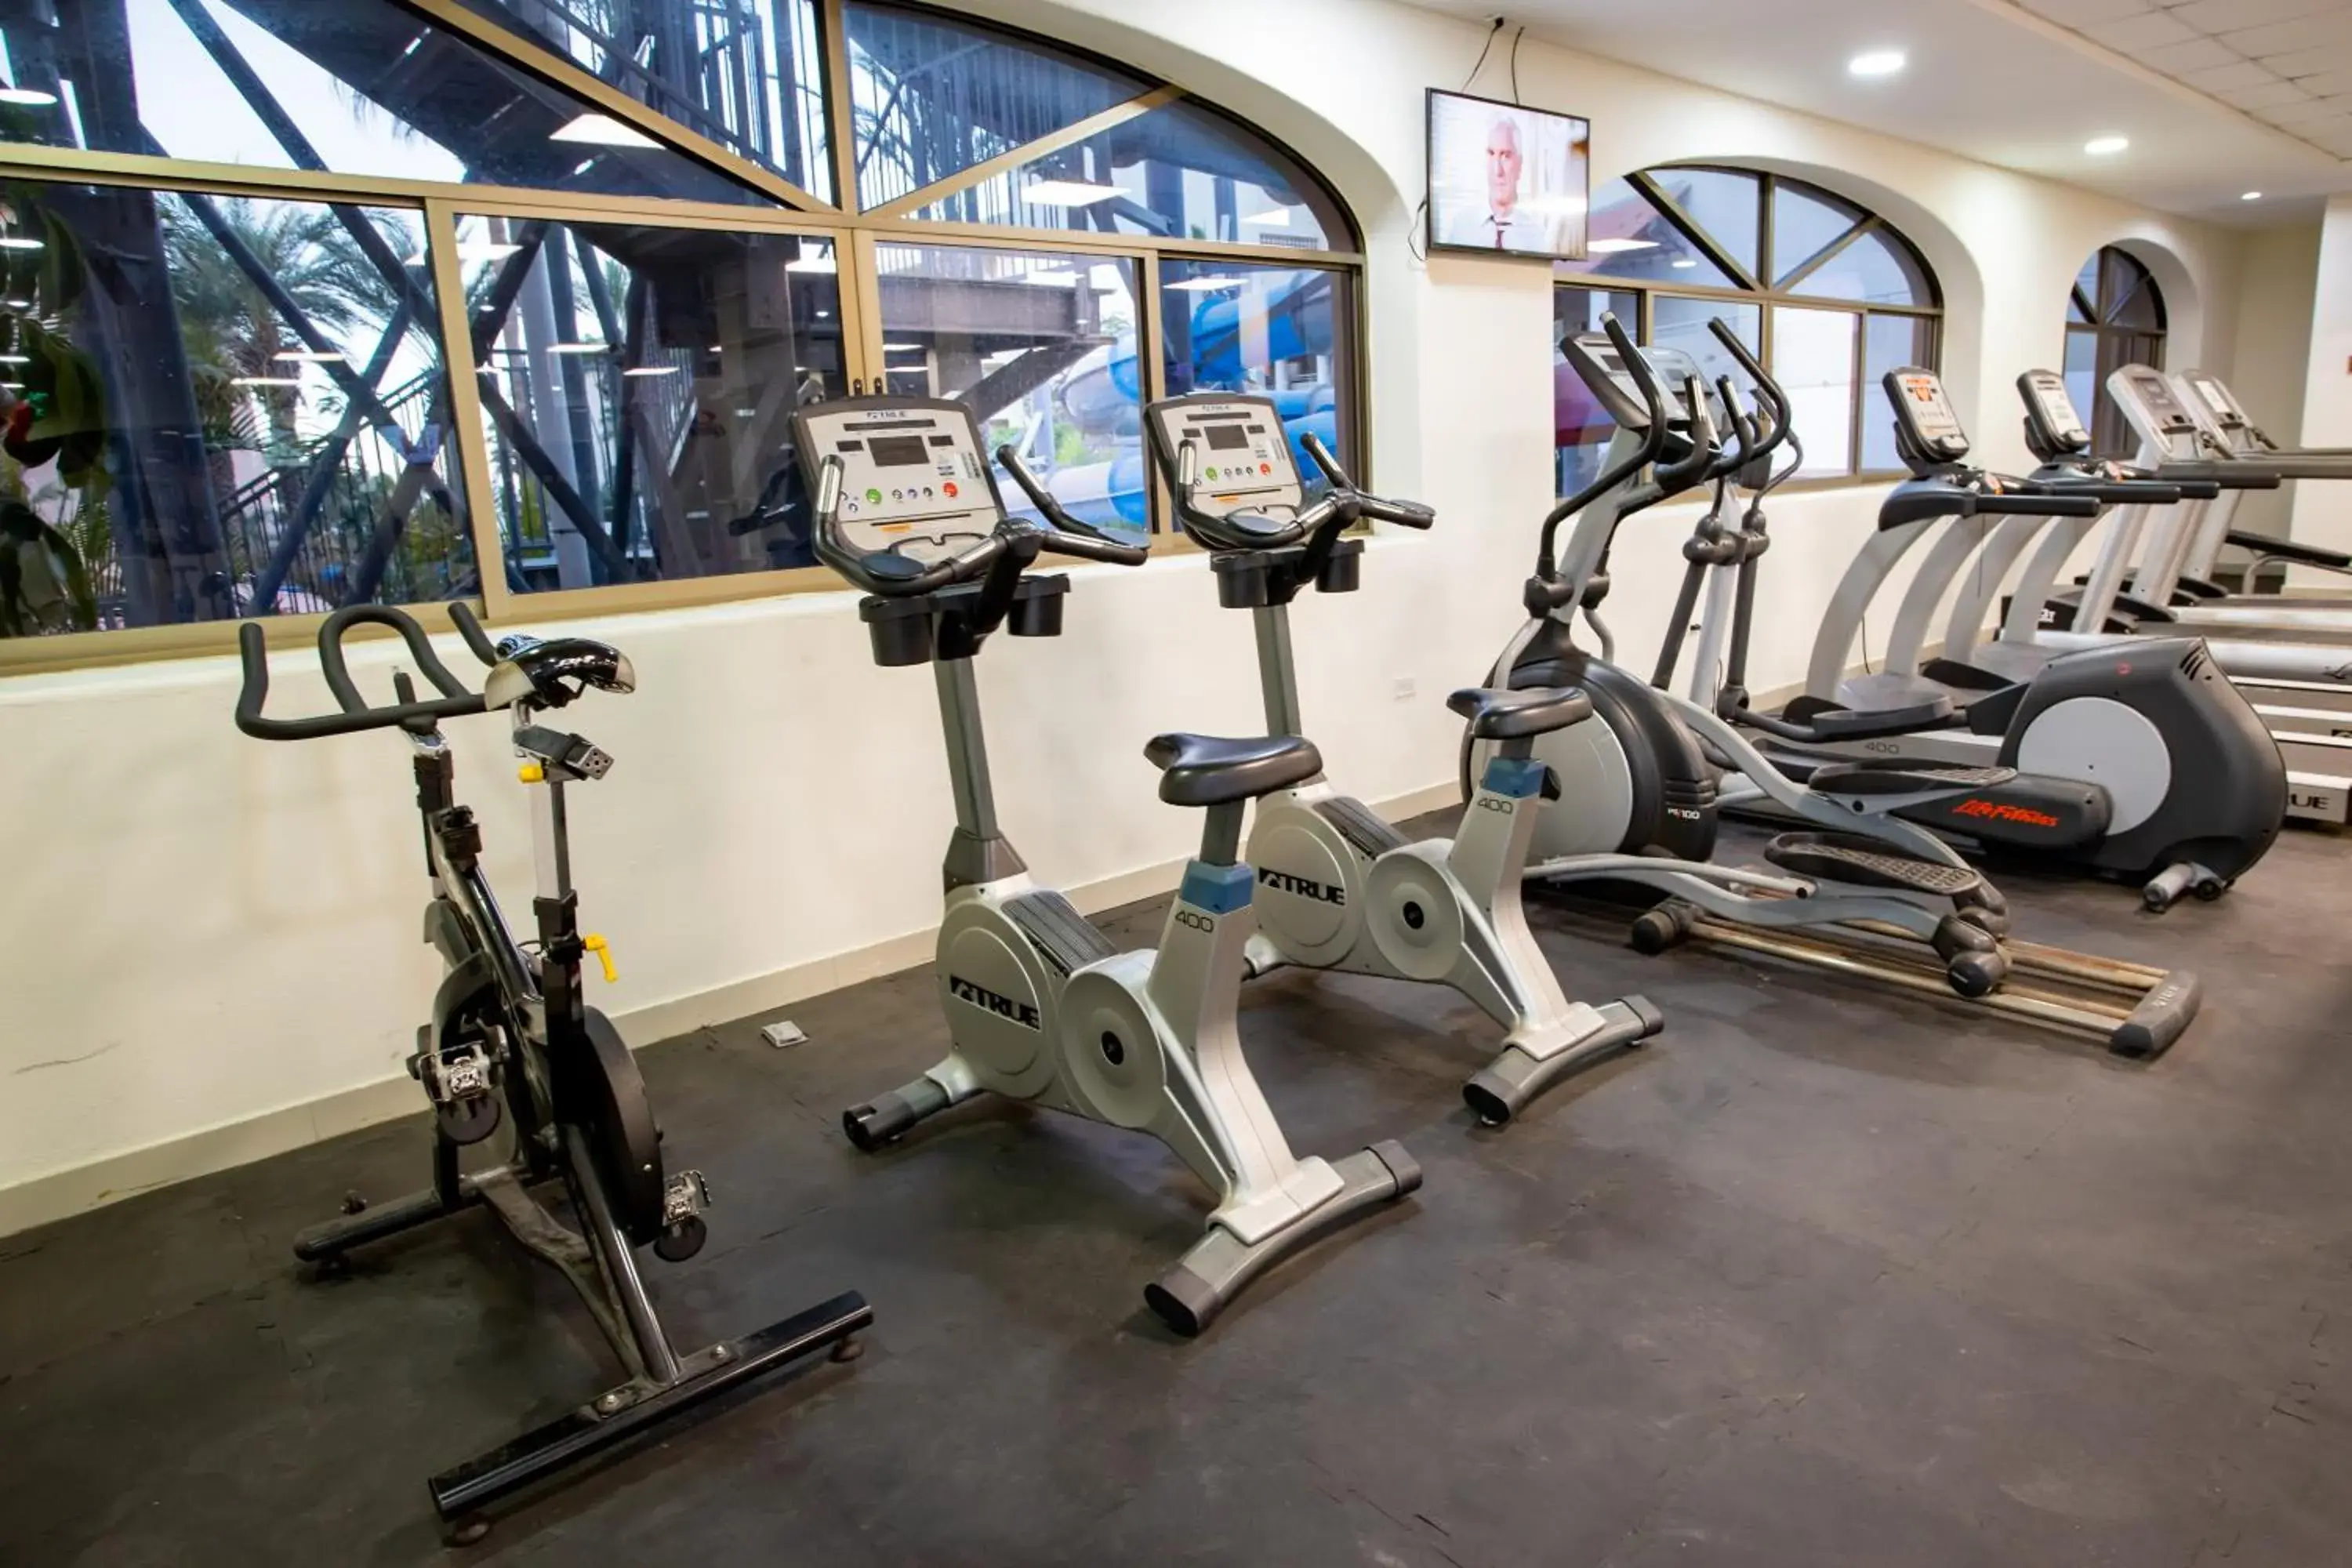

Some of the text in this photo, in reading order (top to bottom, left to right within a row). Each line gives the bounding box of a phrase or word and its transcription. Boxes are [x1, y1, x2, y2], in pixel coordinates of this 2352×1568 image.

[1864, 741, 1900, 755] 400
[1477, 797, 1514, 815] 400
[2290, 793, 2331, 811] UE
[1279, 872, 1346, 906] TRUE
[1175, 910, 1214, 933] 400
[971, 987, 1040, 1030] TRUE
